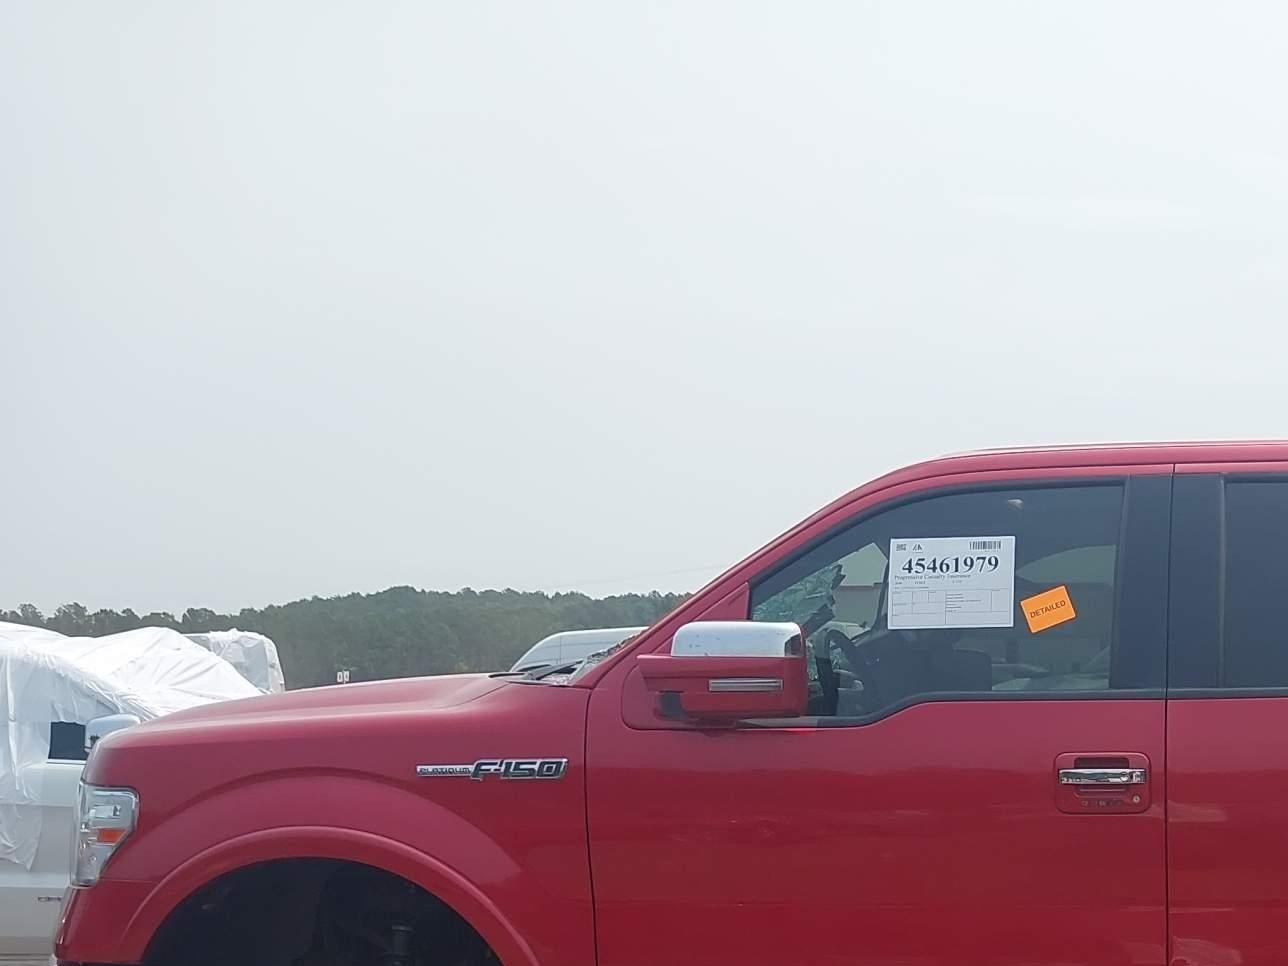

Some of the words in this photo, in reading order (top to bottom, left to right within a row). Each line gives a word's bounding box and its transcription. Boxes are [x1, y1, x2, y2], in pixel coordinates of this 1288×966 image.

[902, 555, 998, 574] 45461979
[1029, 600, 1066, 618] DETAILED
[418, 766, 471, 775] PLATINUM
[470, 758, 569, 781] F-150
